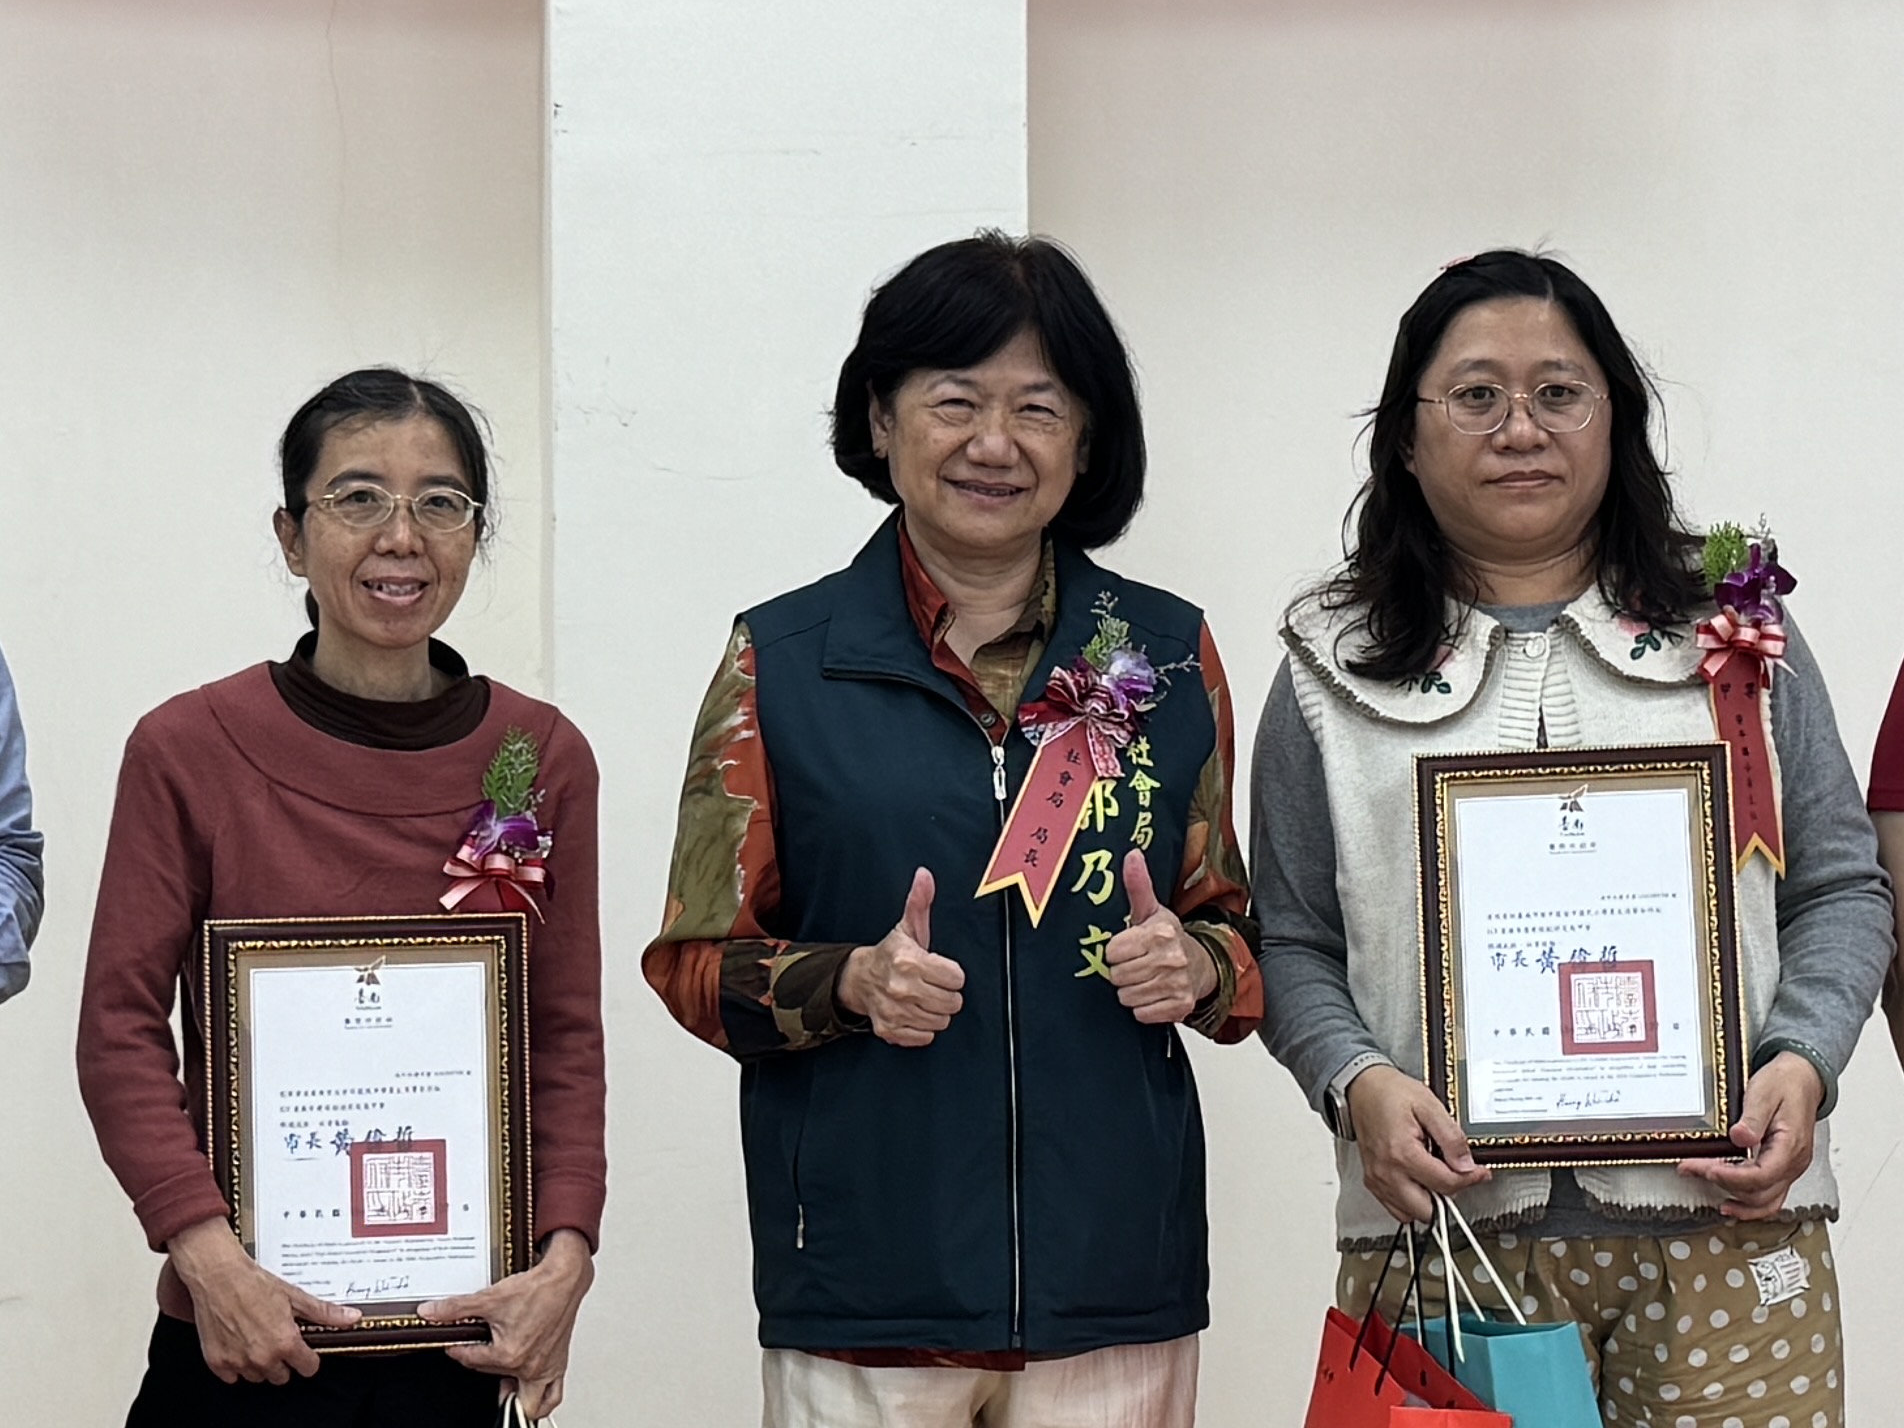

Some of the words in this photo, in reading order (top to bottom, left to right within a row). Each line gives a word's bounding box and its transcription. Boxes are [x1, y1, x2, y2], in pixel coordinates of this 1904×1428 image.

[1045, 747, 1082, 808] 社會局
[1126, 735, 1162, 851] 社會局
[1023, 826, 1049, 868] 局長
